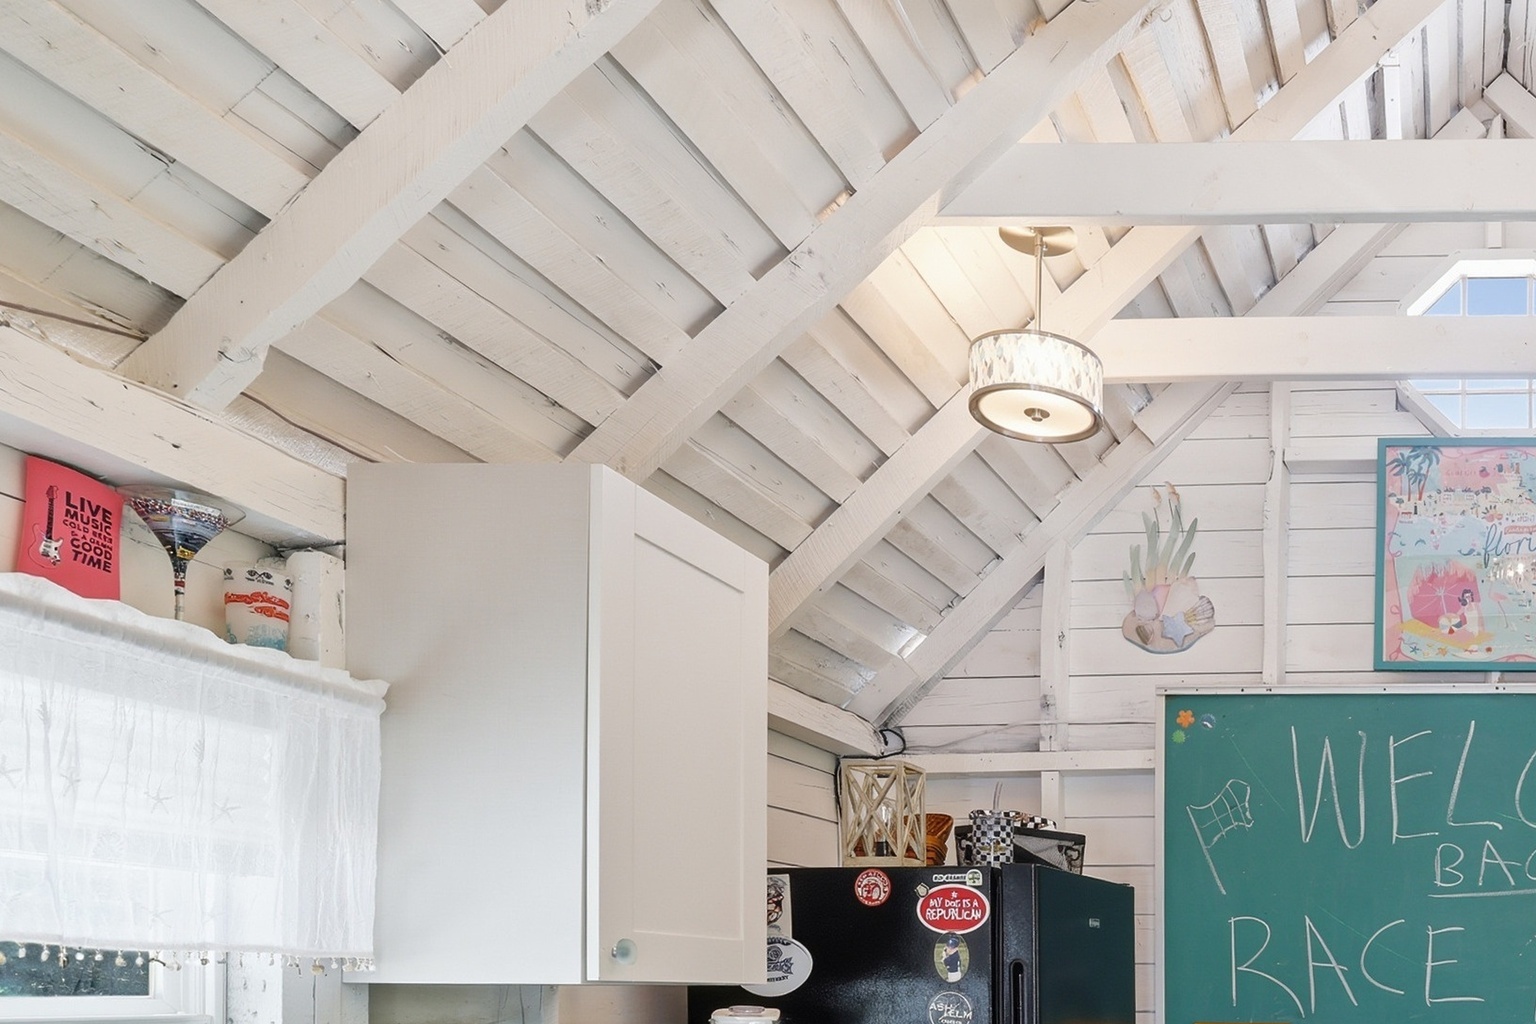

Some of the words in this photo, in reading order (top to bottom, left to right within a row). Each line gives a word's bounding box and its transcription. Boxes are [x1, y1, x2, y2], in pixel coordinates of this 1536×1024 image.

[65, 490, 113, 526] LIVE
[62, 519, 89, 533] COLD
[64, 508, 112, 536] MUSIC
[72, 548, 112, 574] TIME
[925, 908, 982, 921] REPUBLICAN
[929, 897, 943, 908] MY
[944, 899, 961, 908] DOG
[962, 899, 971, 908] IS
[972, 899, 979, 908] A
[1228, 914, 1486, 1019] RACE
